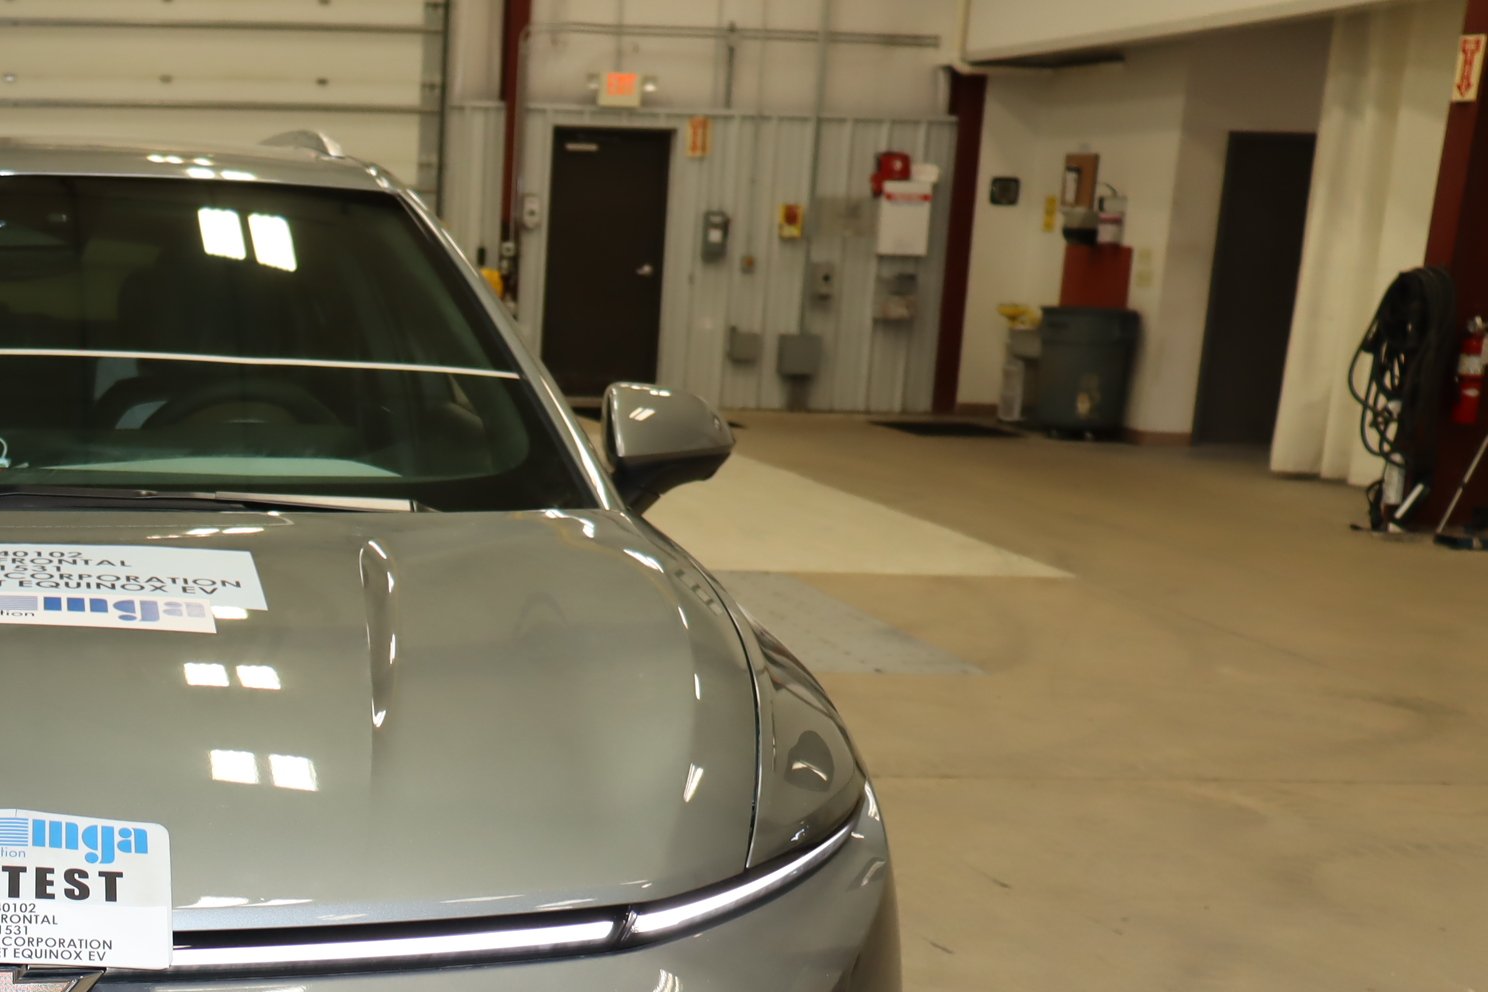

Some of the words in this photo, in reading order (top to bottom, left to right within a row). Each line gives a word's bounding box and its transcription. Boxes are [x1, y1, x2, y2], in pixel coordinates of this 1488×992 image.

[4, 571, 241, 588] CORPORATION
[19, 579, 168, 593] EQUINOX
[182, 586, 218, 595] EV
[43, 596, 206, 622] mga
[32, 819, 148, 864] mga
[1, 936, 113, 950] CORPORATION
[13, 948, 83, 961] EQUINOX
[88, 950, 106, 961] EV
